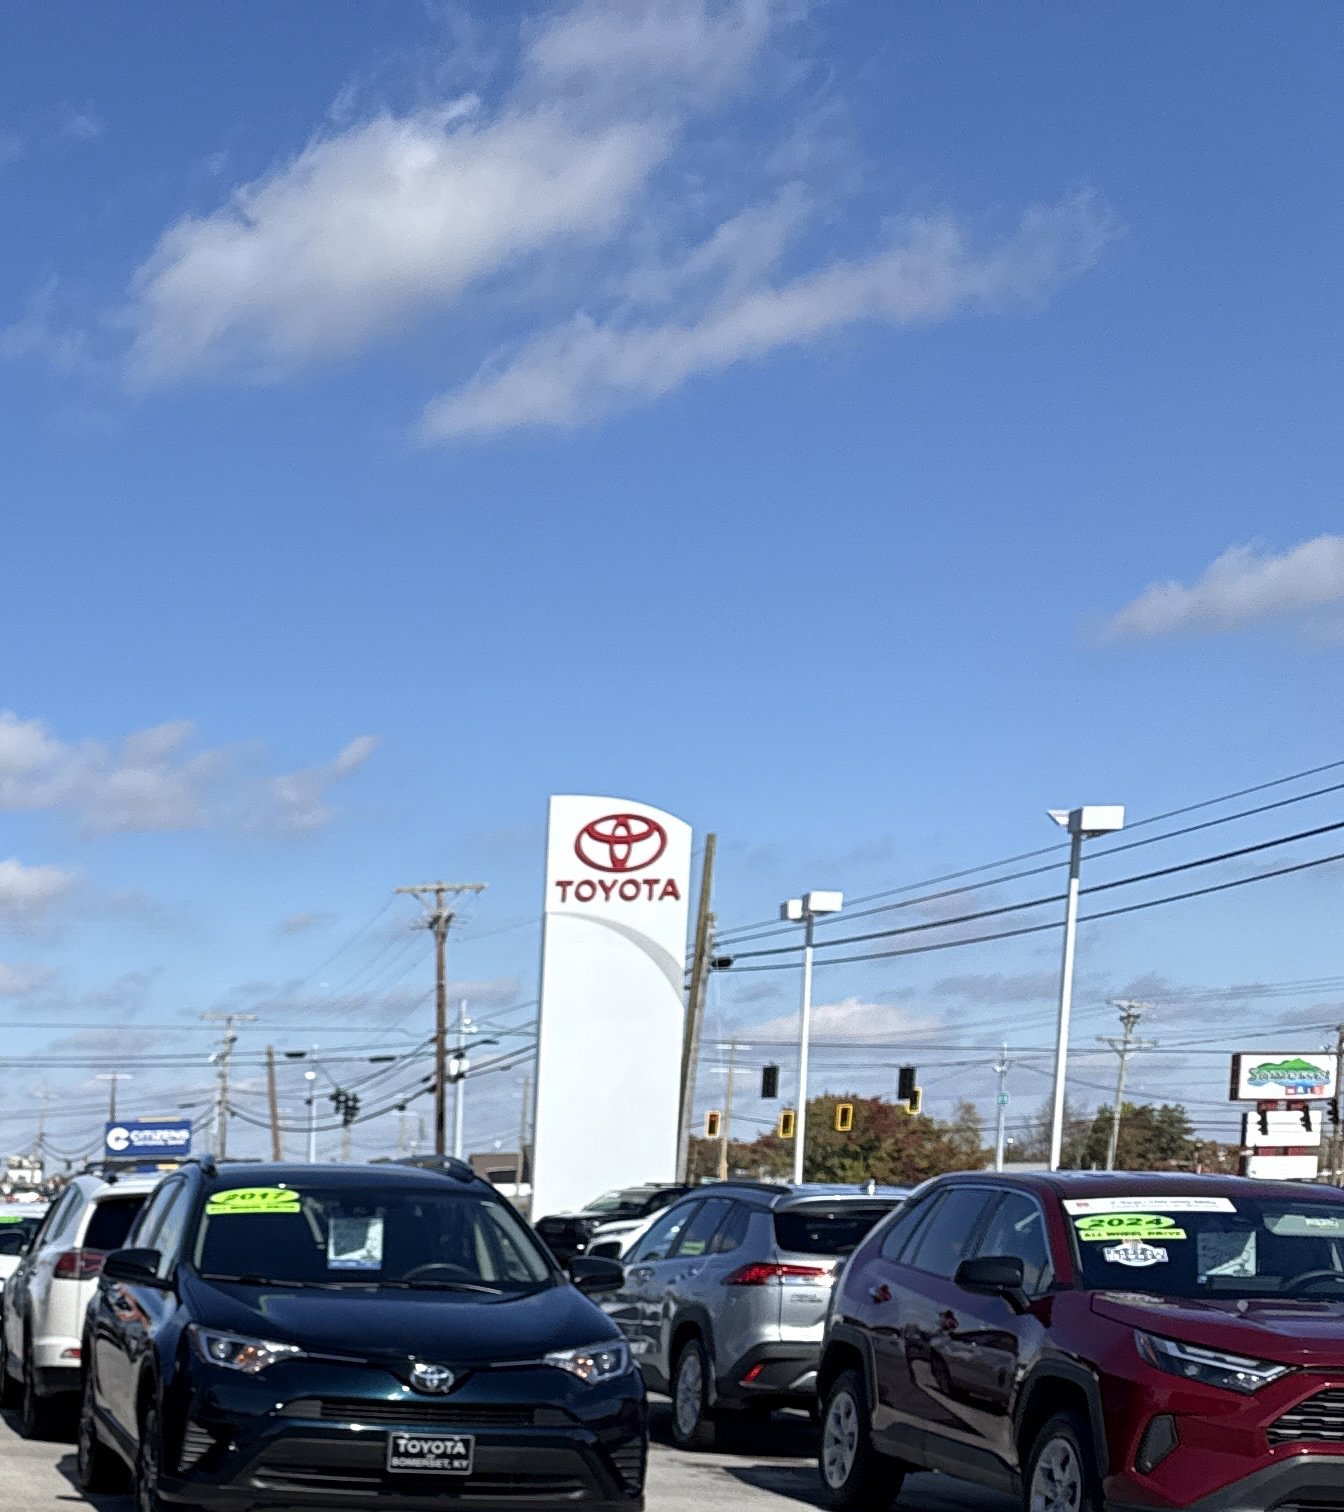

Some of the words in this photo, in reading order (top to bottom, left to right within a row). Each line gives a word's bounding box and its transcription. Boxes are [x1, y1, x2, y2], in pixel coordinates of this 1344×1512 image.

[555, 878, 681, 903] TOYOTA
[1088, 1217, 1163, 1229] 2024
[396, 1439, 467, 1455] TOYOTA
